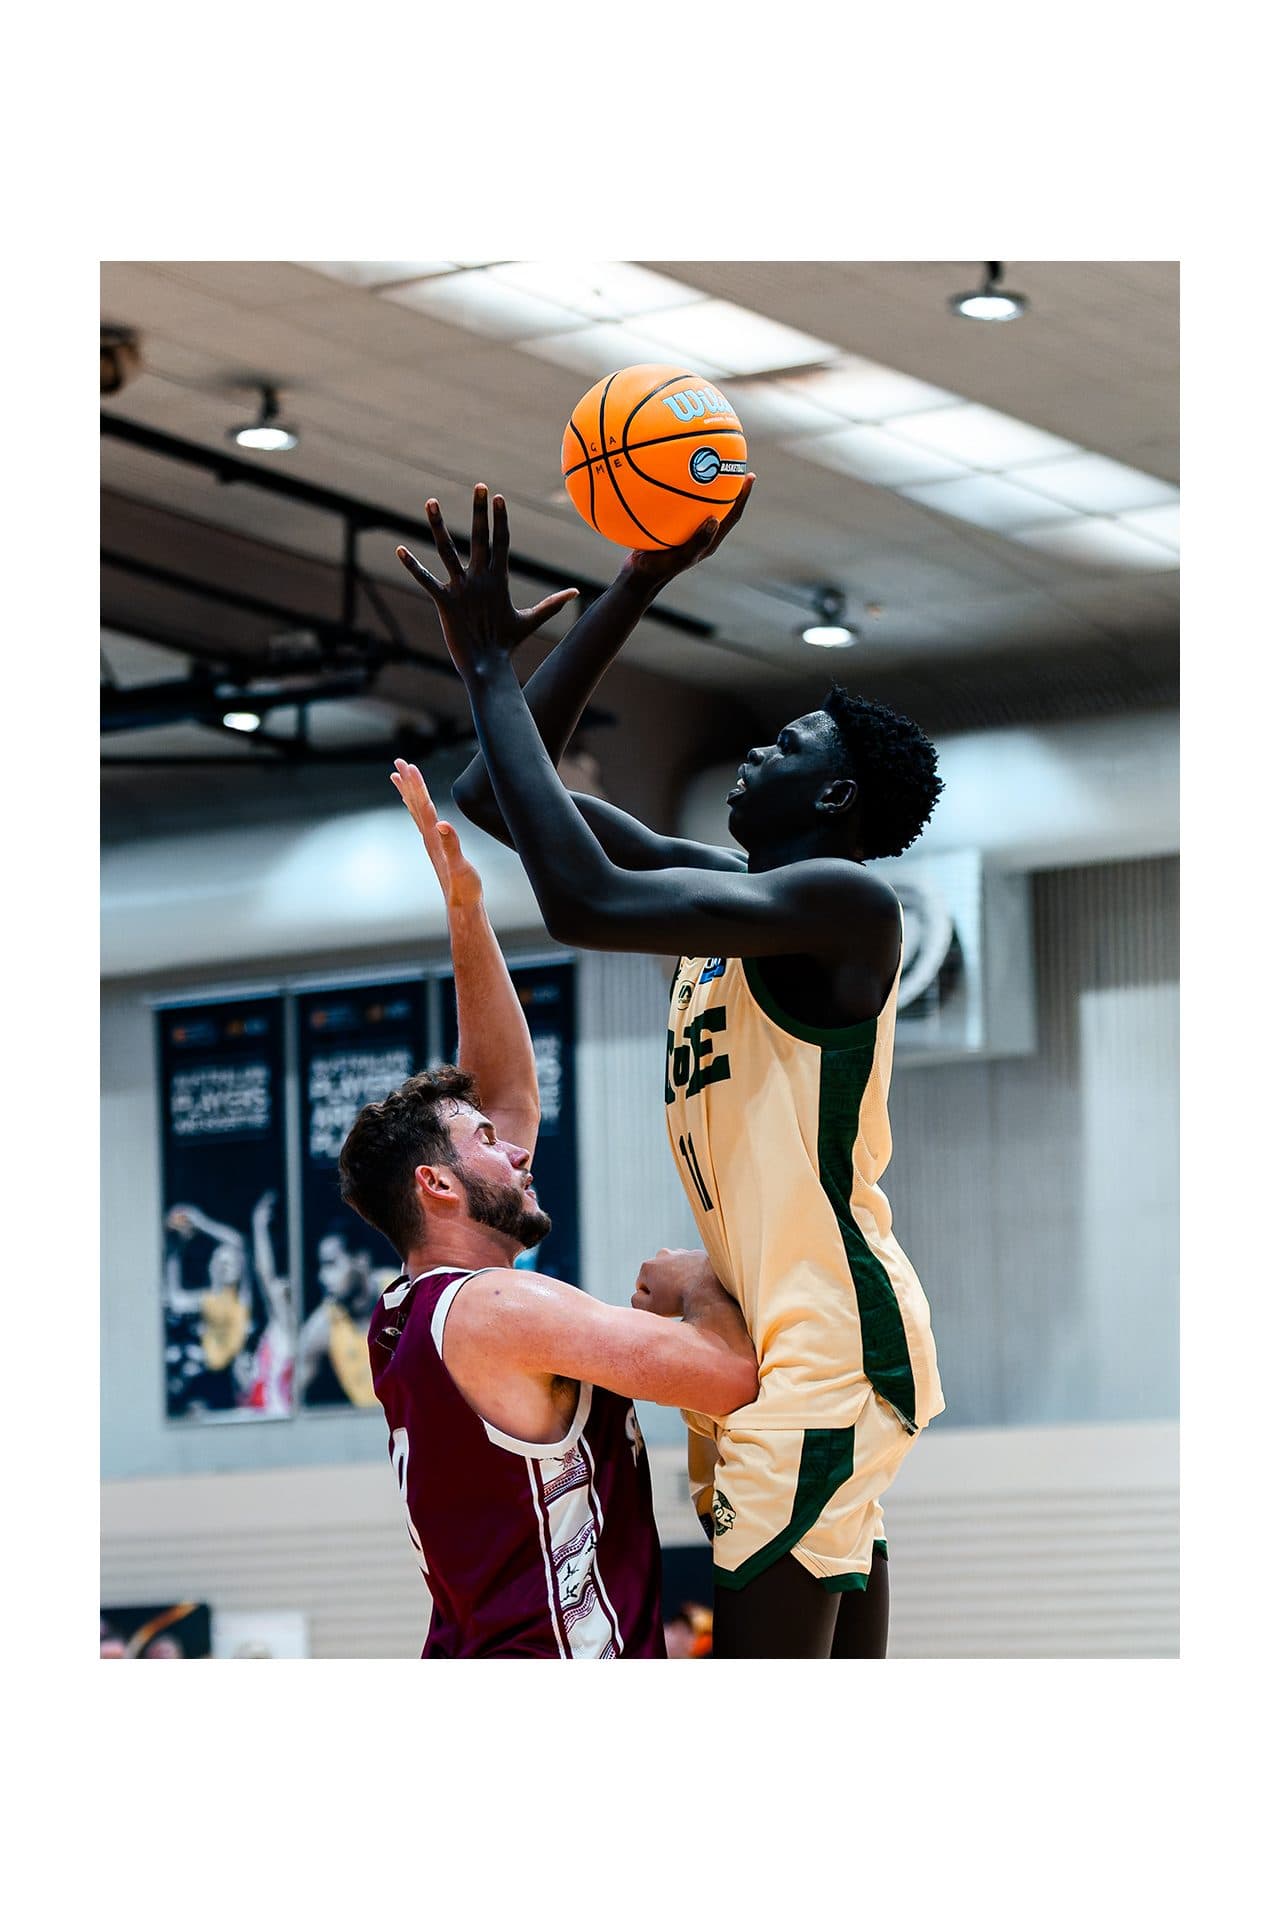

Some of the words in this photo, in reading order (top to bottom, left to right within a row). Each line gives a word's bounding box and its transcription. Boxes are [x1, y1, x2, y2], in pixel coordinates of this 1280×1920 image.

[663, 388, 734, 422] Wil
[720, 462, 745, 472] BASKET
[679, 1132, 714, 1213] 11
